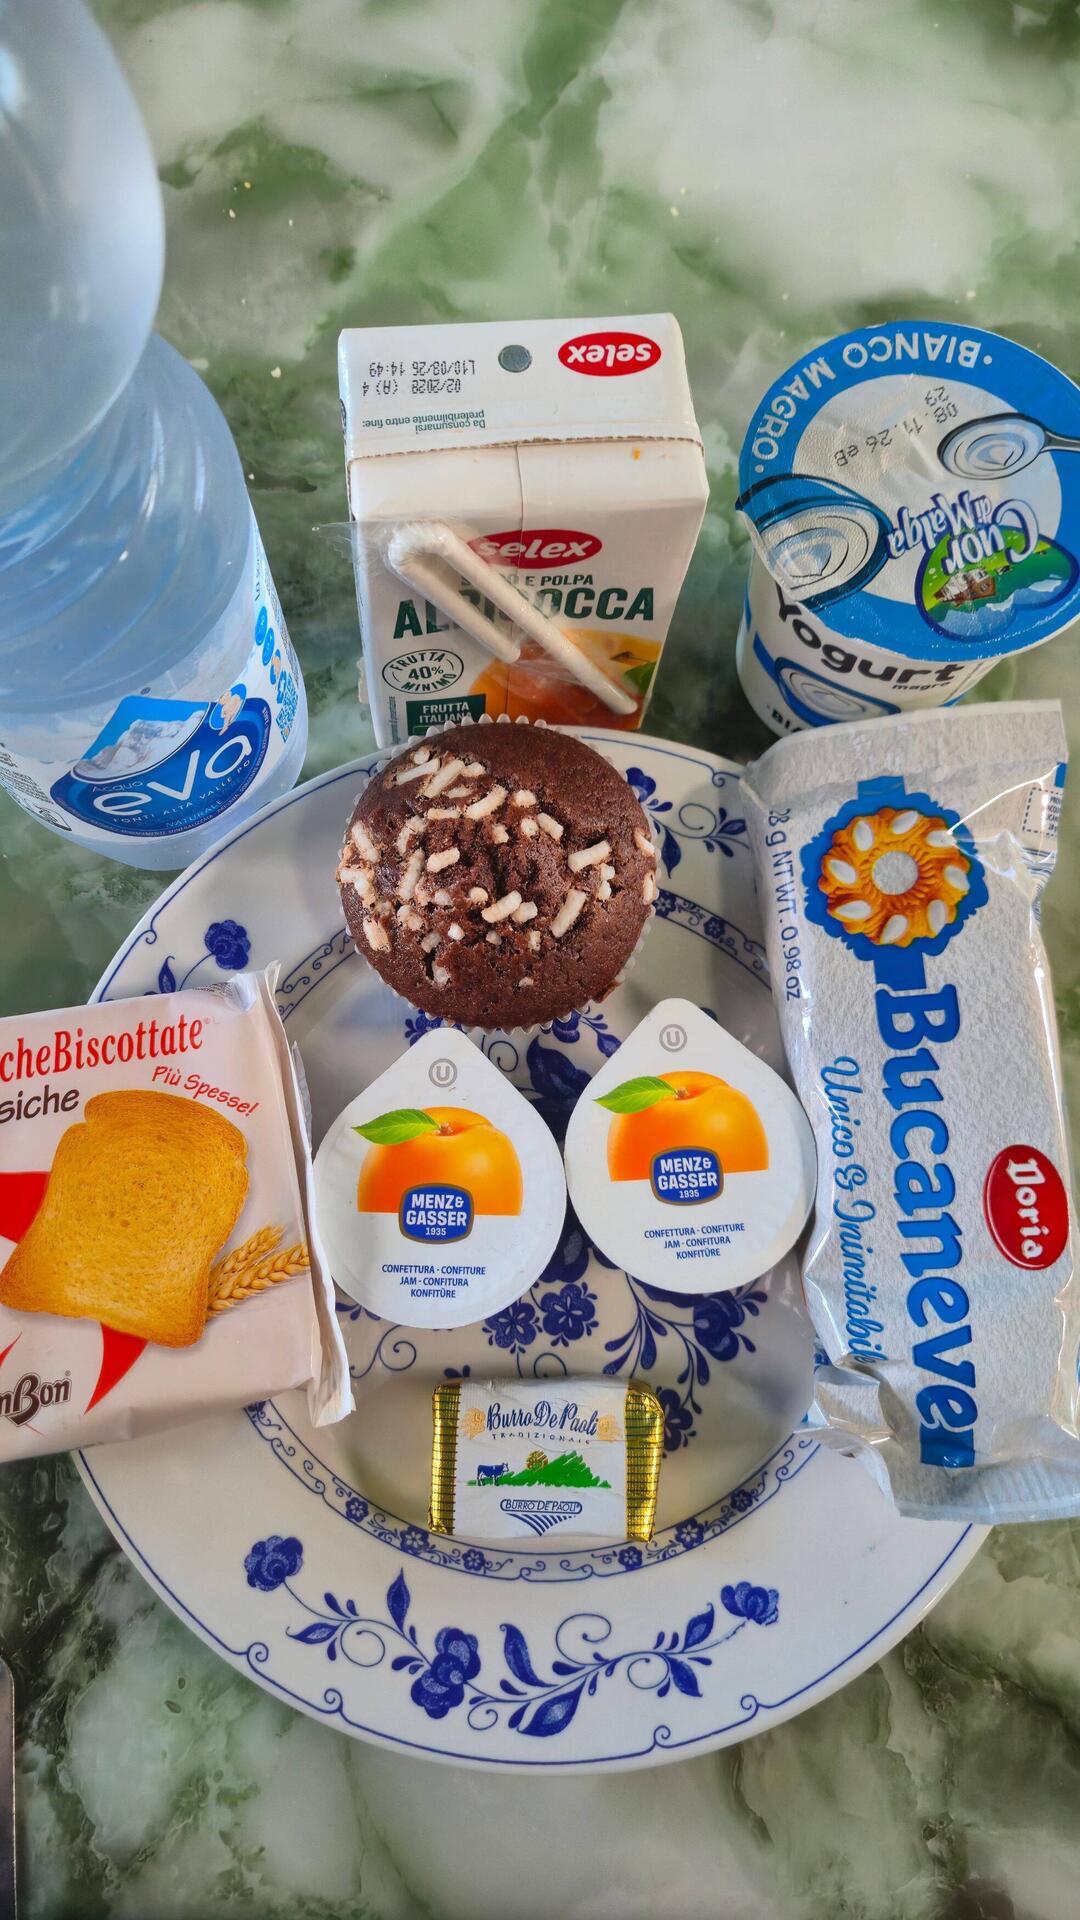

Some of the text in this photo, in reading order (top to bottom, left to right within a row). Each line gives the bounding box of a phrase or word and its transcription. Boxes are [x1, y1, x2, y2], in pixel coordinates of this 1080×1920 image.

[567, 342, 652, 368] selex
[369, 361, 405, 378] 14:49
[362, 381, 370, 397] 4
[752, 332, 982, 461] BIANCO MAGRO
[362, 409, 485, 429] preferibilmente entro fine:
[415, 420, 486, 435] Da consumarsi
[885, 489, 975, 559] Malga
[942, 499, 1039, 575] Cuor
[478, 538, 593, 560] selex
[525, 574, 535, 586] E
[540, 573, 594, 587] POLPA
[775, 581, 964, 684] Yogurt
[390, 651, 446, 671] FRUTTA
[408, 666, 444, 680] 40%
[401, 673, 457, 692] MINIMO
[892, 681, 950, 692] magro
[422, 702, 470, 714] FRUTTA
[419, 712, 473, 724] ITALIANA
[163, 802, 193, 816] ALTA
[200, 776, 233, 800] VALLE
[237, 759, 251, 774] PO
[766, 830, 788, 848] g
[781, 926, 801, 973] 0.98
[152, 1064, 261, 1117] Più Spesse!
[821, 1055, 863, 1158] Unico
[660, 1156, 712, 1174] MENZ&
[658, 1171, 718, 1191] GASSER
[834, 1163, 867, 1192] &
[411, 1193, 465, 1209] MENZ&
[679, 1188, 700, 1199] 1935
[875, 983, 979, 1430] Bucaneve
[1006, 1158, 1049, 1260] Doria
[406, 1211, 467, 1227] GASSER
[425, 1227, 447, 1237] 1935
[644, 1223, 745, 1239] CONFETTURA CONFITURE
[664, 1236, 731, 1250] JAM CONFITURA
[676, 1248, 721, 1260] KONFITÜRE
[381, 1263, 486, 1276] CONFETTURA CONFITURE
[400, 1276, 469, 1287] JAM CONFITURA
[410, 1287, 456, 1299] KONFITÜRE
[491, 1431, 590, 1445] TRADIZIONALE
[505, 1498, 577, 1512] BURRO DE PAOLI
